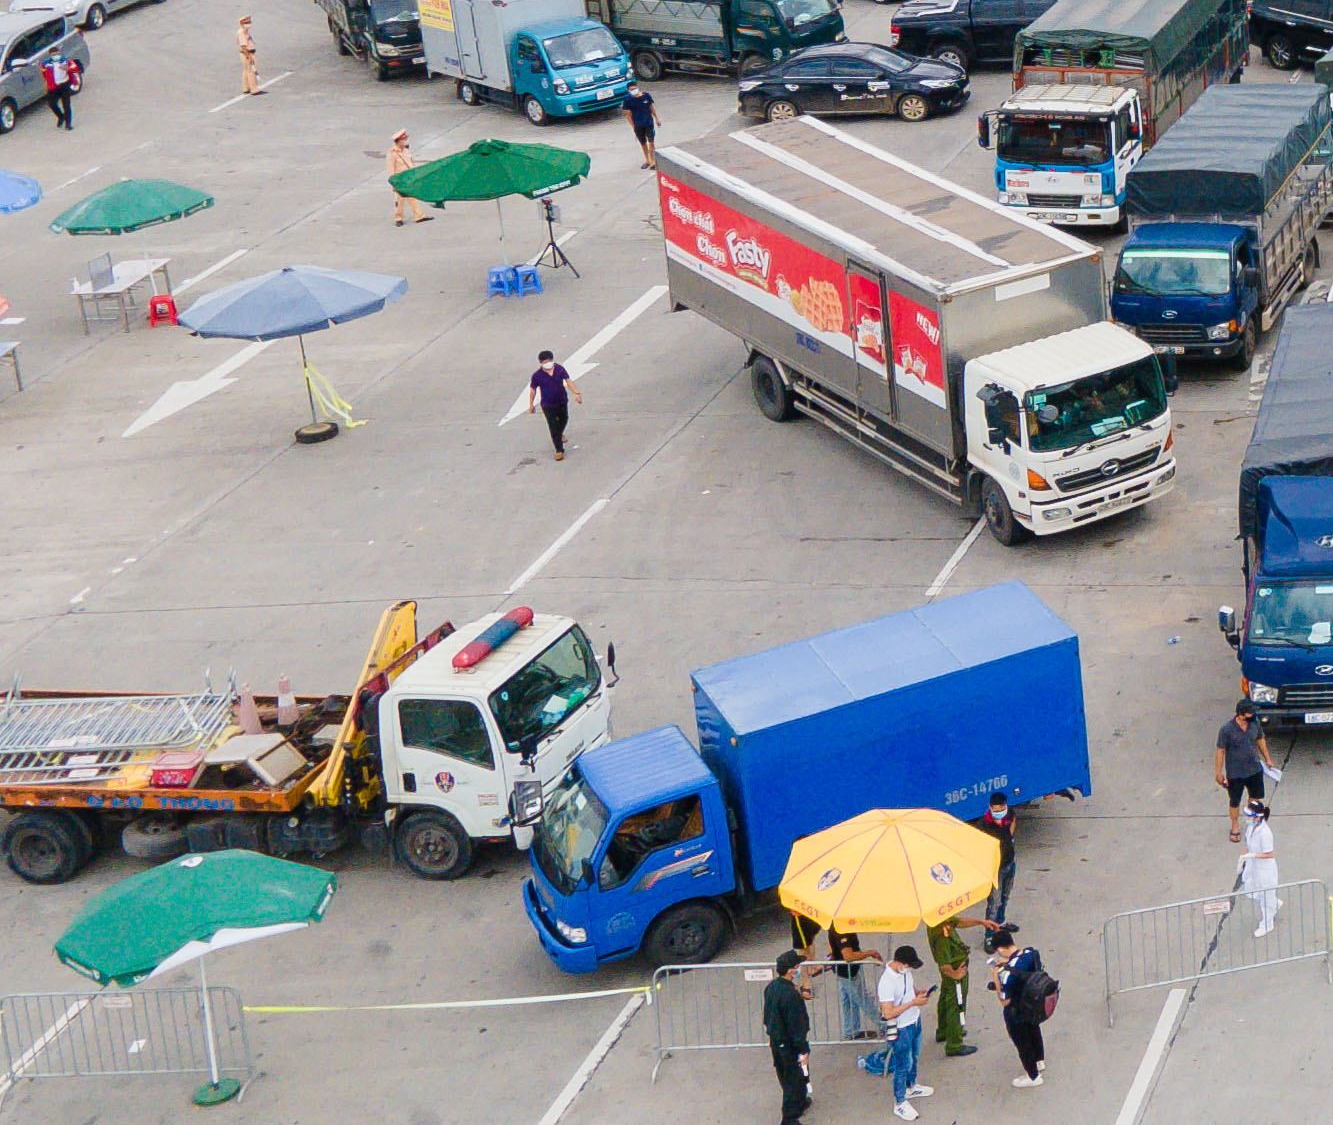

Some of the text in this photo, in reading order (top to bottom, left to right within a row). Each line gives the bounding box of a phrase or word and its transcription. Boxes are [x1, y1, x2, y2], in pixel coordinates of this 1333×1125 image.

[725, 228, 772, 278] Fasty
[916, 312, 940, 345] NEW!
[938, 891, 973, 916] CSGT
